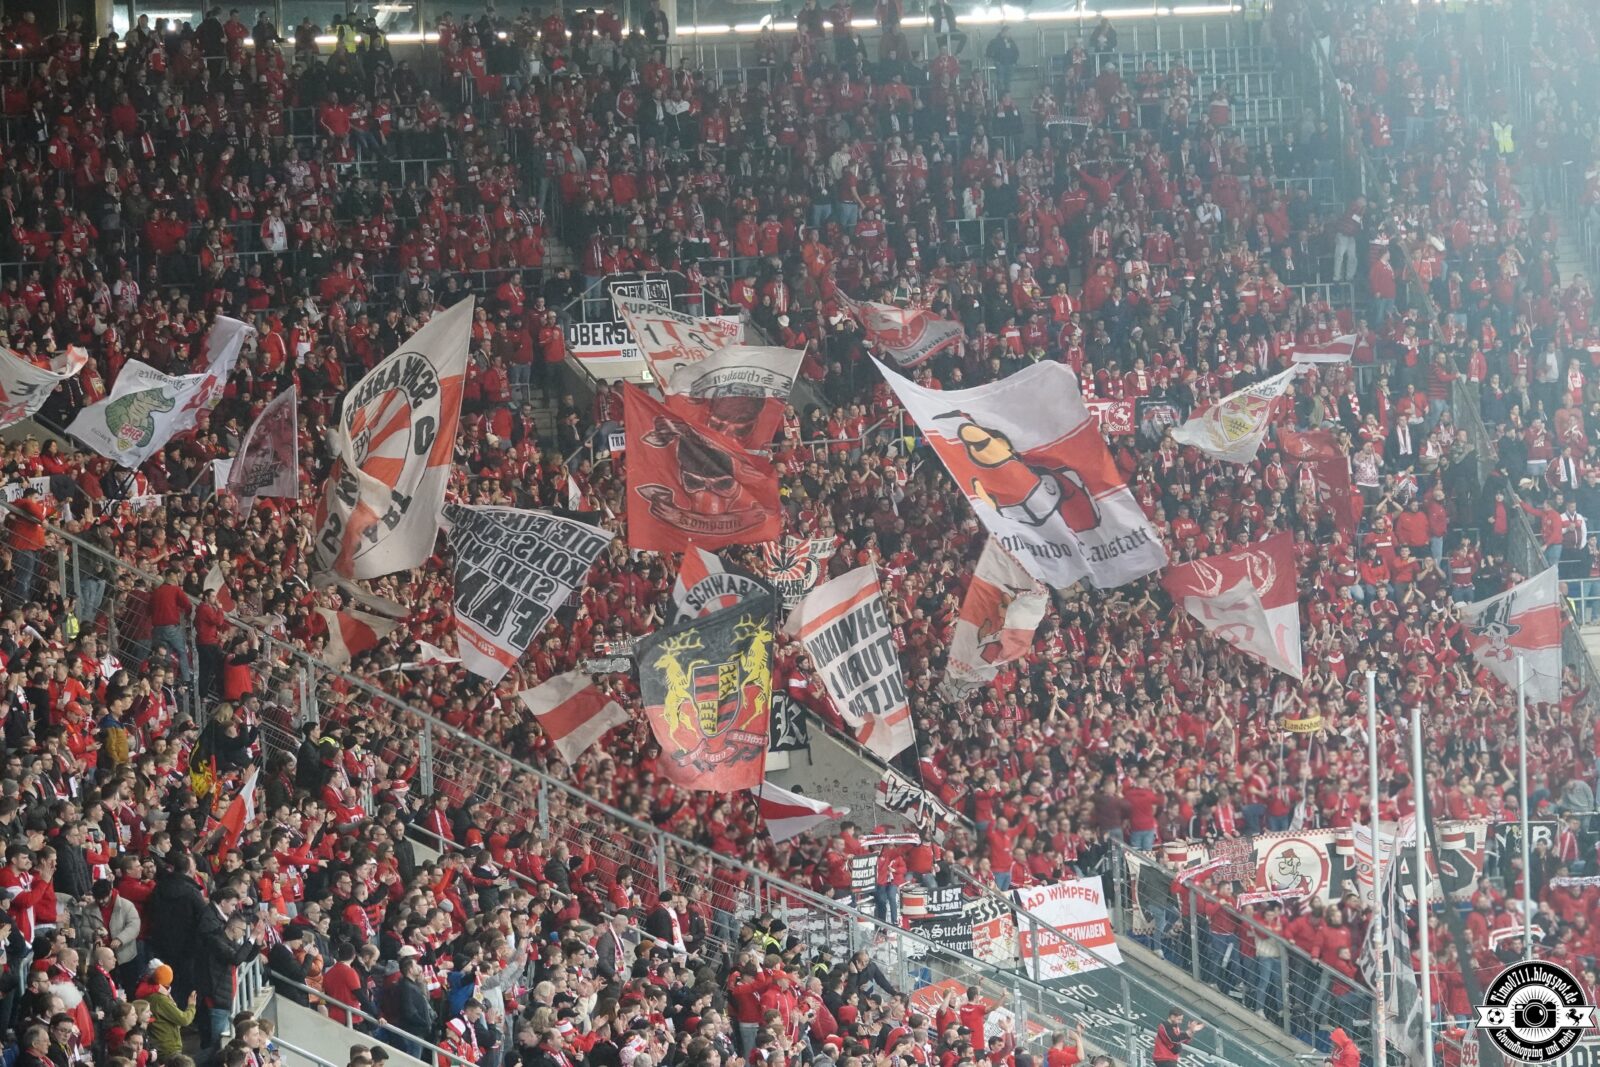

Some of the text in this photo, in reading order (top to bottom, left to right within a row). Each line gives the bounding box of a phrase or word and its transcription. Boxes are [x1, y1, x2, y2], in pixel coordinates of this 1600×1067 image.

[622, 348, 638, 358] SEIT
[941, 887, 962, 902] IST
[1047, 886, 1100, 906] WIMPFEN
[931, 922, 973, 939] Suebia
[1025, 930, 1061, 949] SUFER
